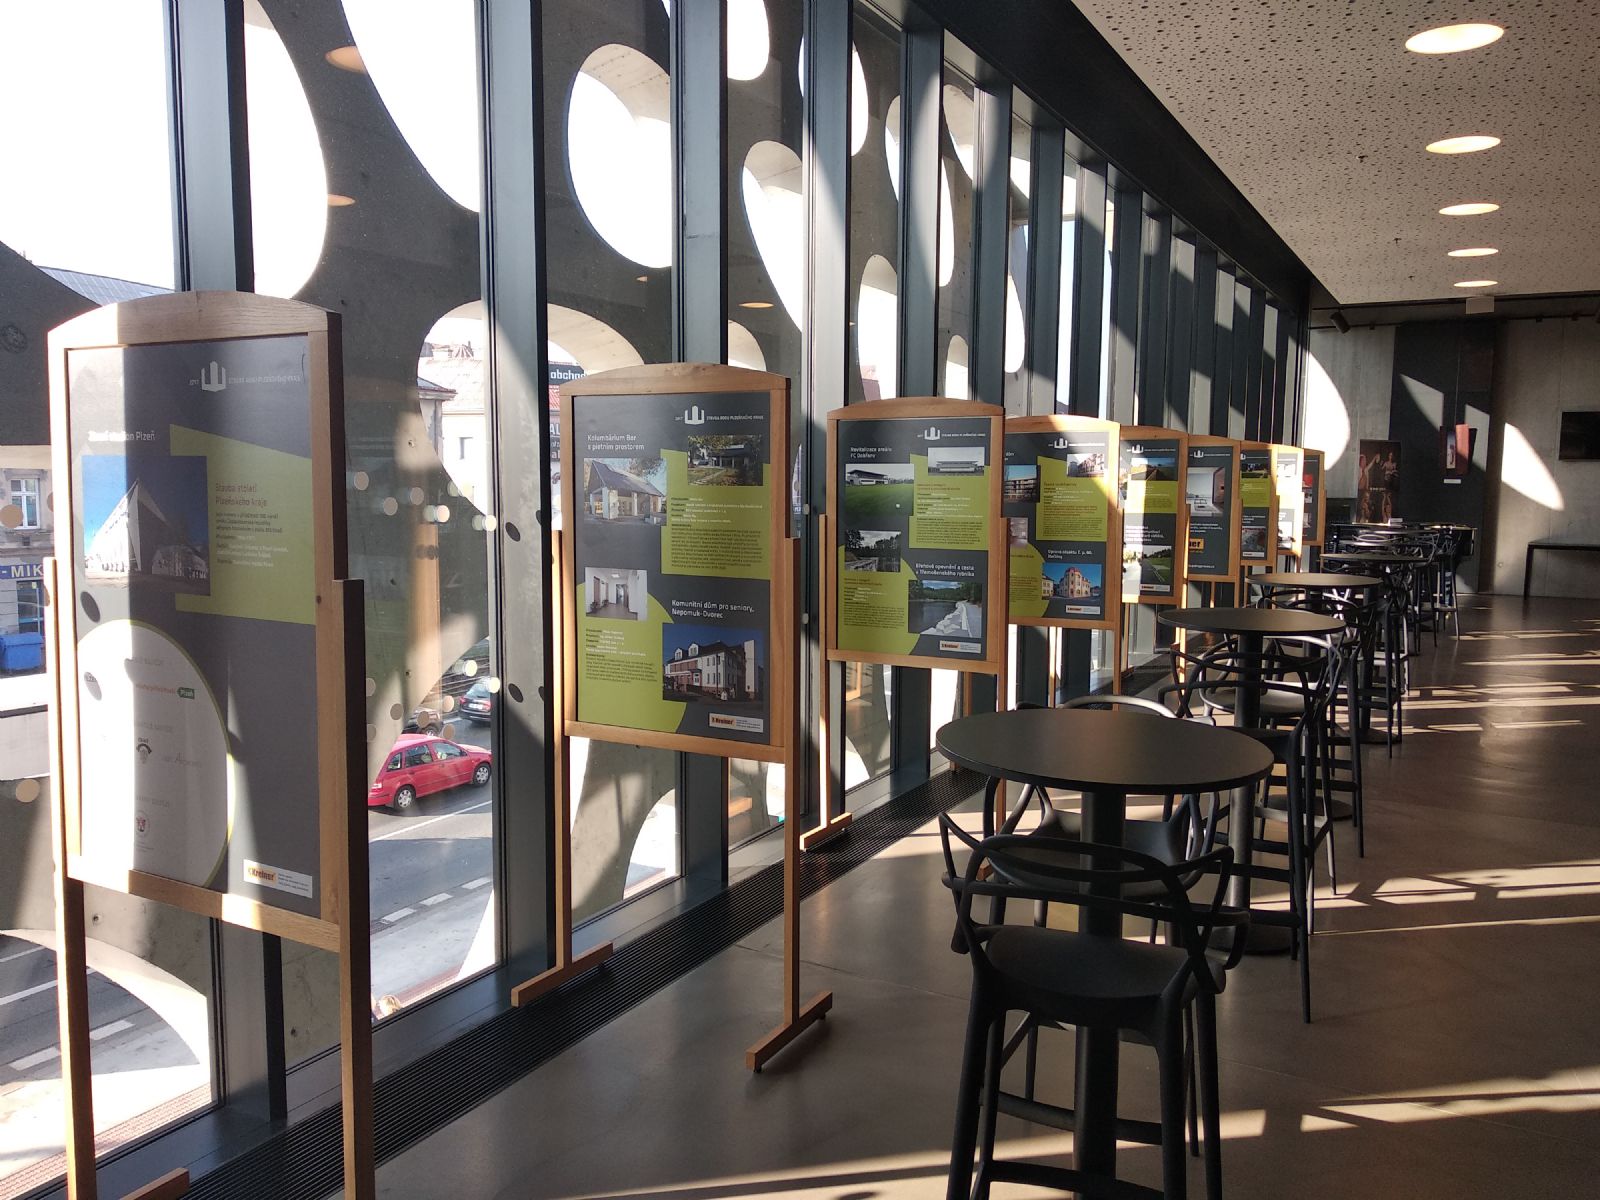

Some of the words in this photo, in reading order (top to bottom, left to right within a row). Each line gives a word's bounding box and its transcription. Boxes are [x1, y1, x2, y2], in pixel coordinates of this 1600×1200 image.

[671, 599, 703, 609] Komunitní
[703, 601, 718, 609] dům
[718, 603, 729, 611] pro
